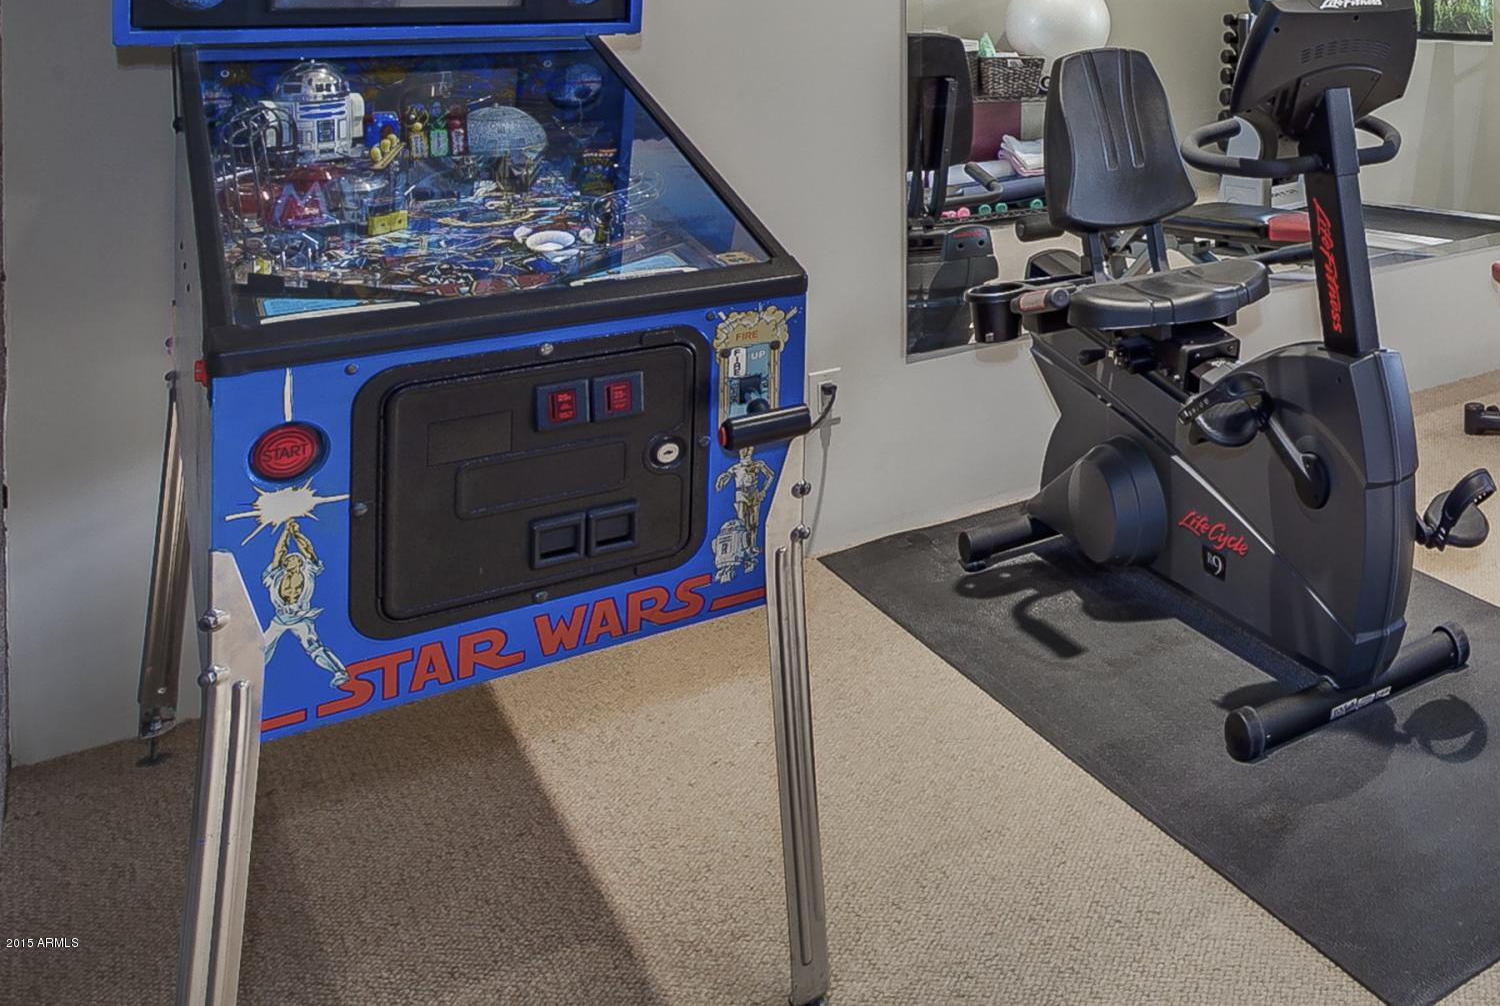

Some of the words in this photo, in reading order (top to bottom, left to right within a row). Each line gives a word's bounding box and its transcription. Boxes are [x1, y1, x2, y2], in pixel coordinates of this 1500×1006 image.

[736, 330, 759, 341] FIRE
[751, 350, 766, 360] UP
[262, 442, 309, 463] START
[316, 628, 526, 718] STAR
[533, 574, 712, 657] WARS
